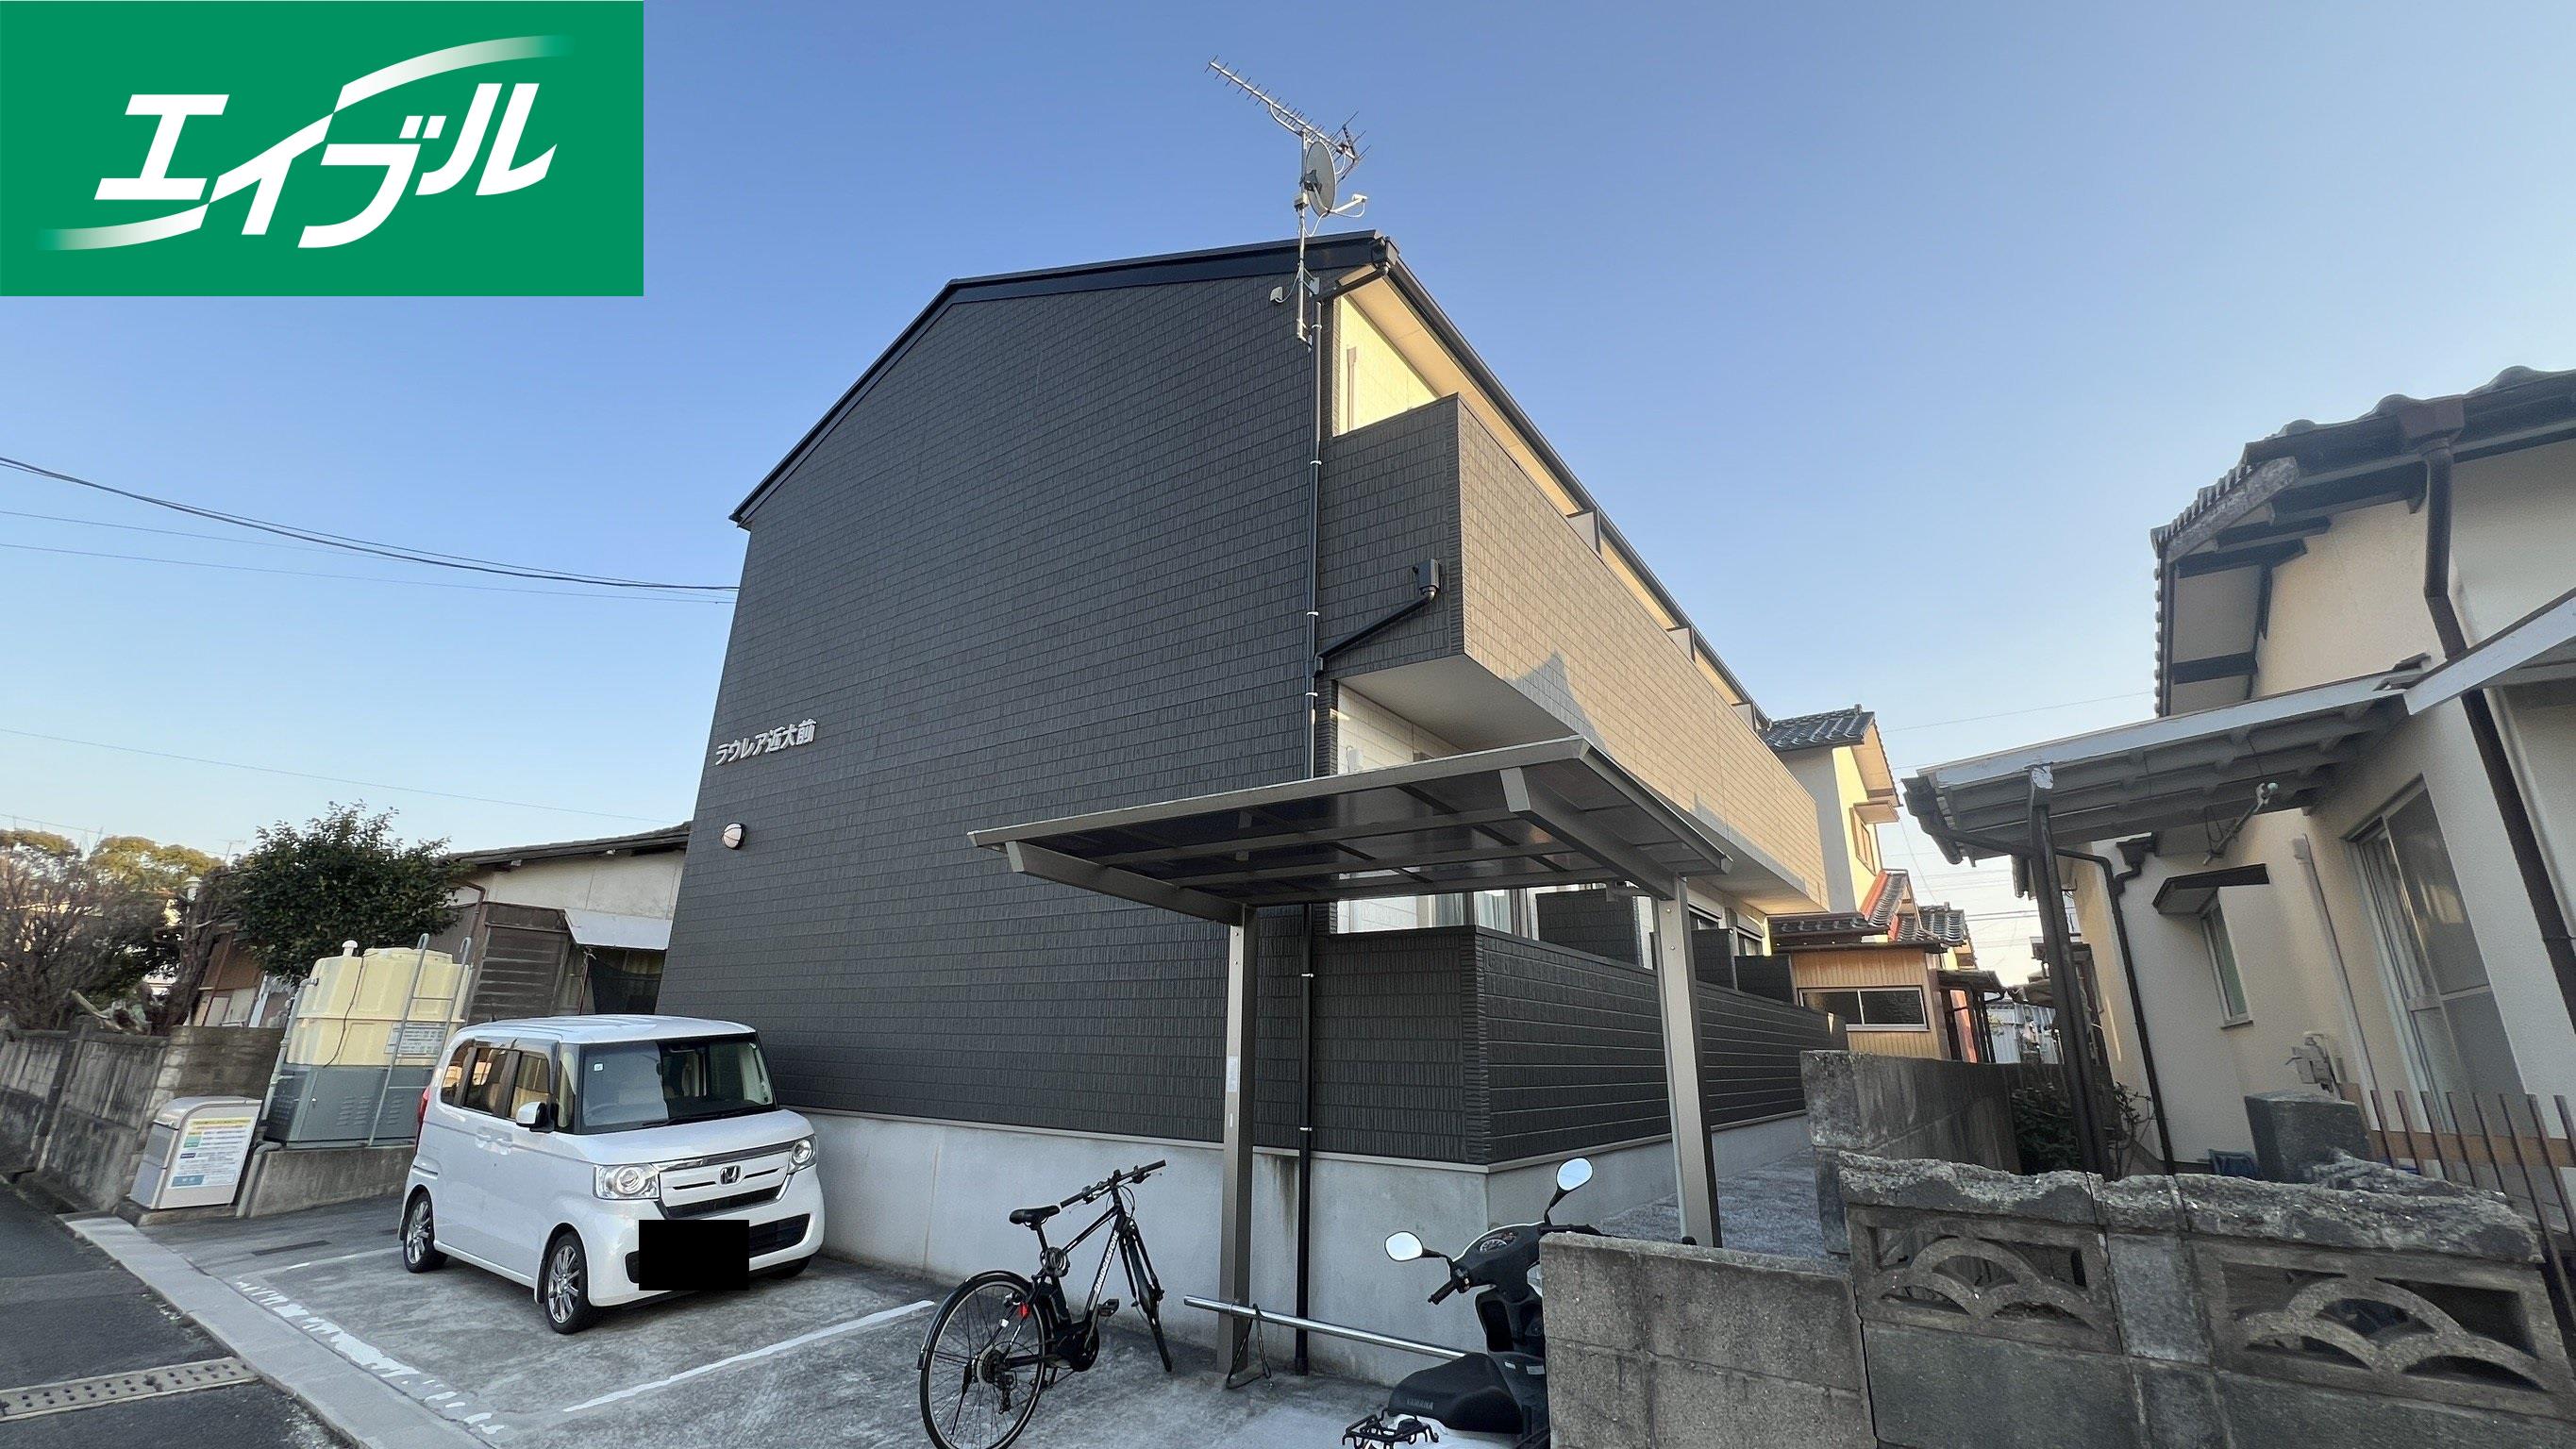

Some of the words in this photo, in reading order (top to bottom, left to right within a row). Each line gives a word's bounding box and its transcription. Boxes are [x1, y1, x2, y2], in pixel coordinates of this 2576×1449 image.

[715, 718, 817, 765] ラウレア近大前
